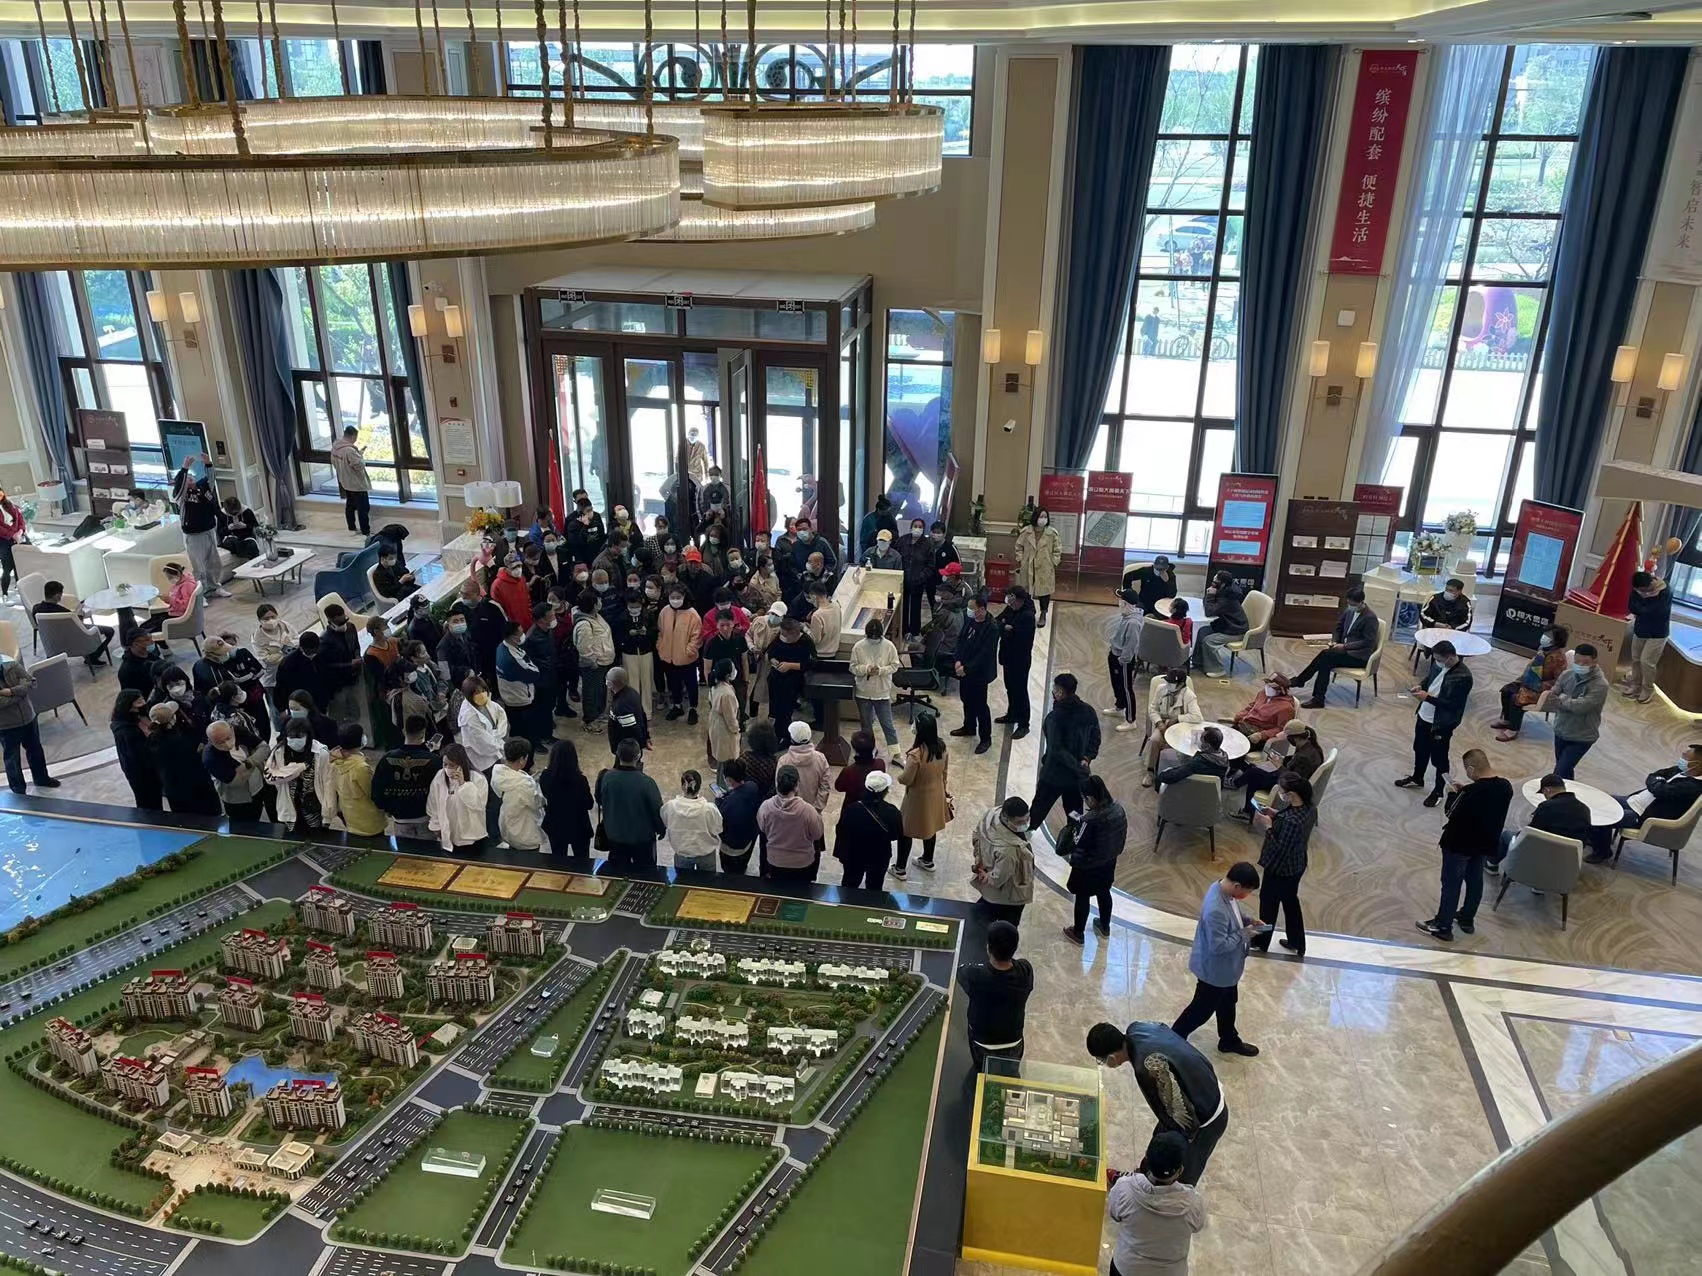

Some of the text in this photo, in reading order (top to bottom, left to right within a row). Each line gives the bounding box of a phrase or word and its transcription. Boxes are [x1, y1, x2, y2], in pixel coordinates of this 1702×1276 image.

[1365, 88, 1392, 160] 缤纷配套
[1352, 173, 1377, 243] 便捷生活
